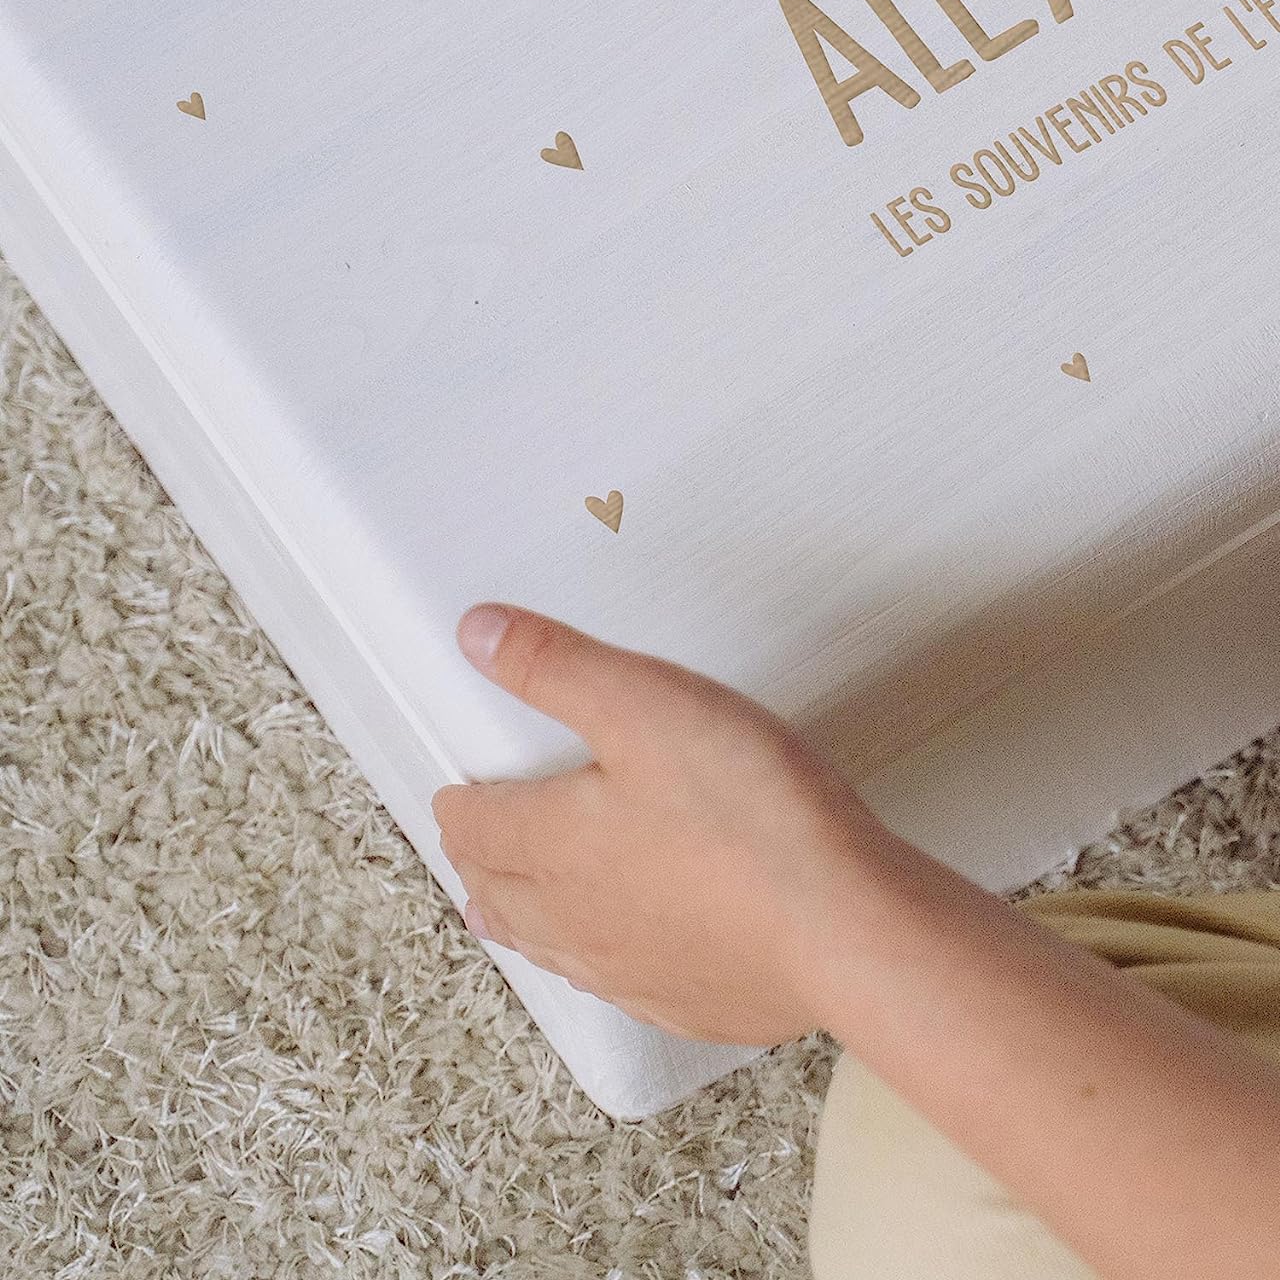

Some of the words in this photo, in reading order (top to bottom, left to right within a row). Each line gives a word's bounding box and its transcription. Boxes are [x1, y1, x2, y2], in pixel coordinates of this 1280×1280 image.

[869, 187, 951, 257] LES
[950, 60, 1168, 210] SOUVENIRS
[1162, 22, 1232, 85] DE
